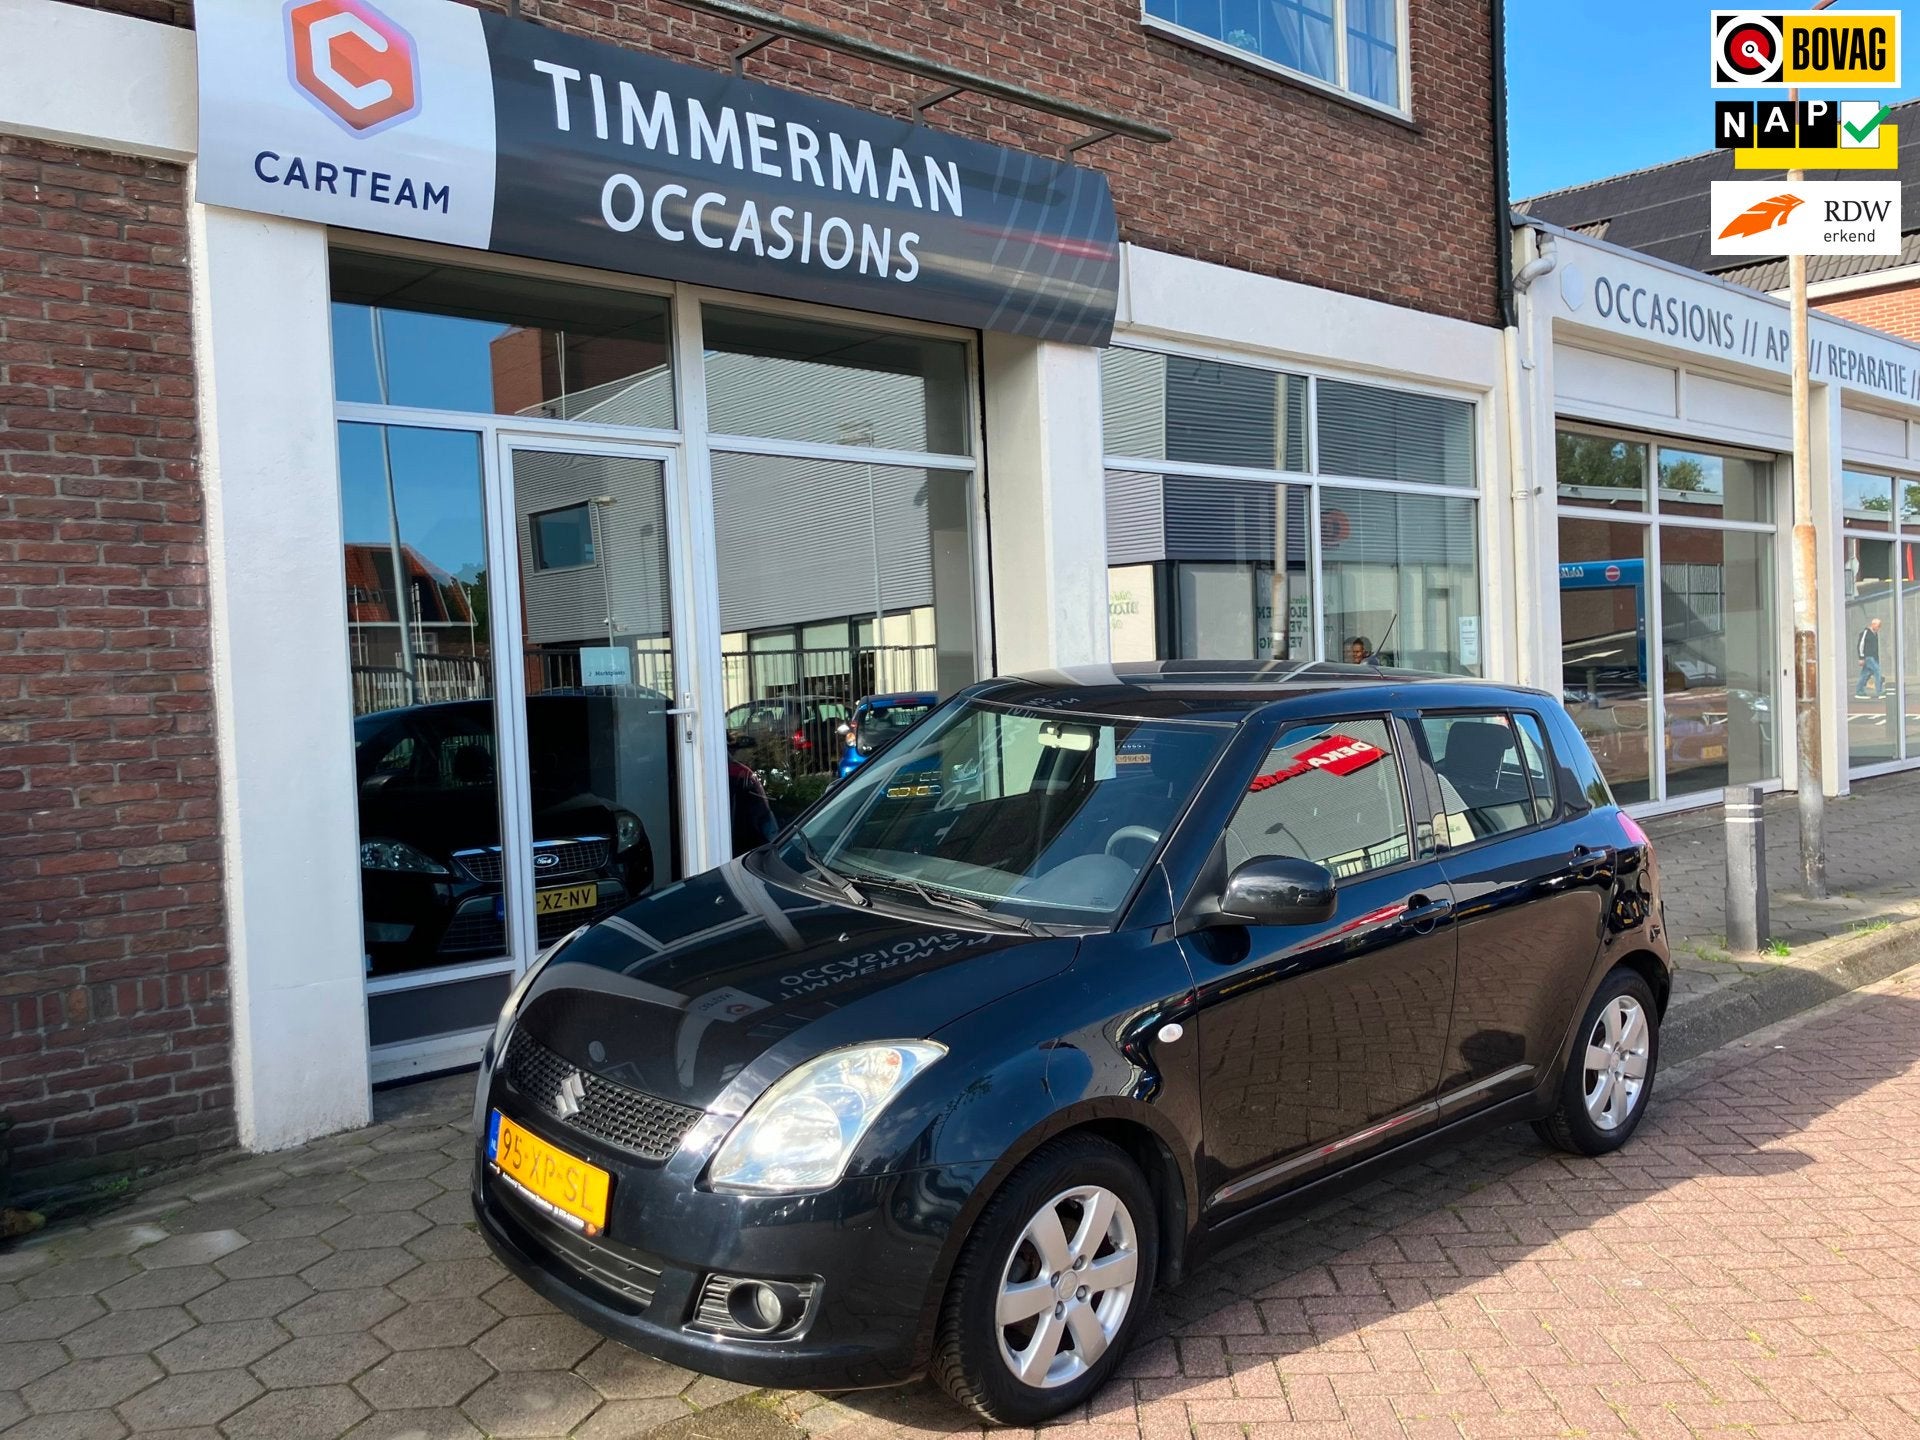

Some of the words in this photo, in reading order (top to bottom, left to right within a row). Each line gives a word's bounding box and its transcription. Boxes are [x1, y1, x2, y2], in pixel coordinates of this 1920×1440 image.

[254, 150, 451, 214] CARTEAM
[533, 59, 964, 217] TIMMERMAN
[601, 172, 921, 282] OCCASIONS
[1594, 276, 1735, 350] OCCASIONS
[1765, 325, 1790, 363] AP
[1828, 343, 1908, 396] REPARATIE
[503, 1127, 593, 1212] 95-XP-SL
